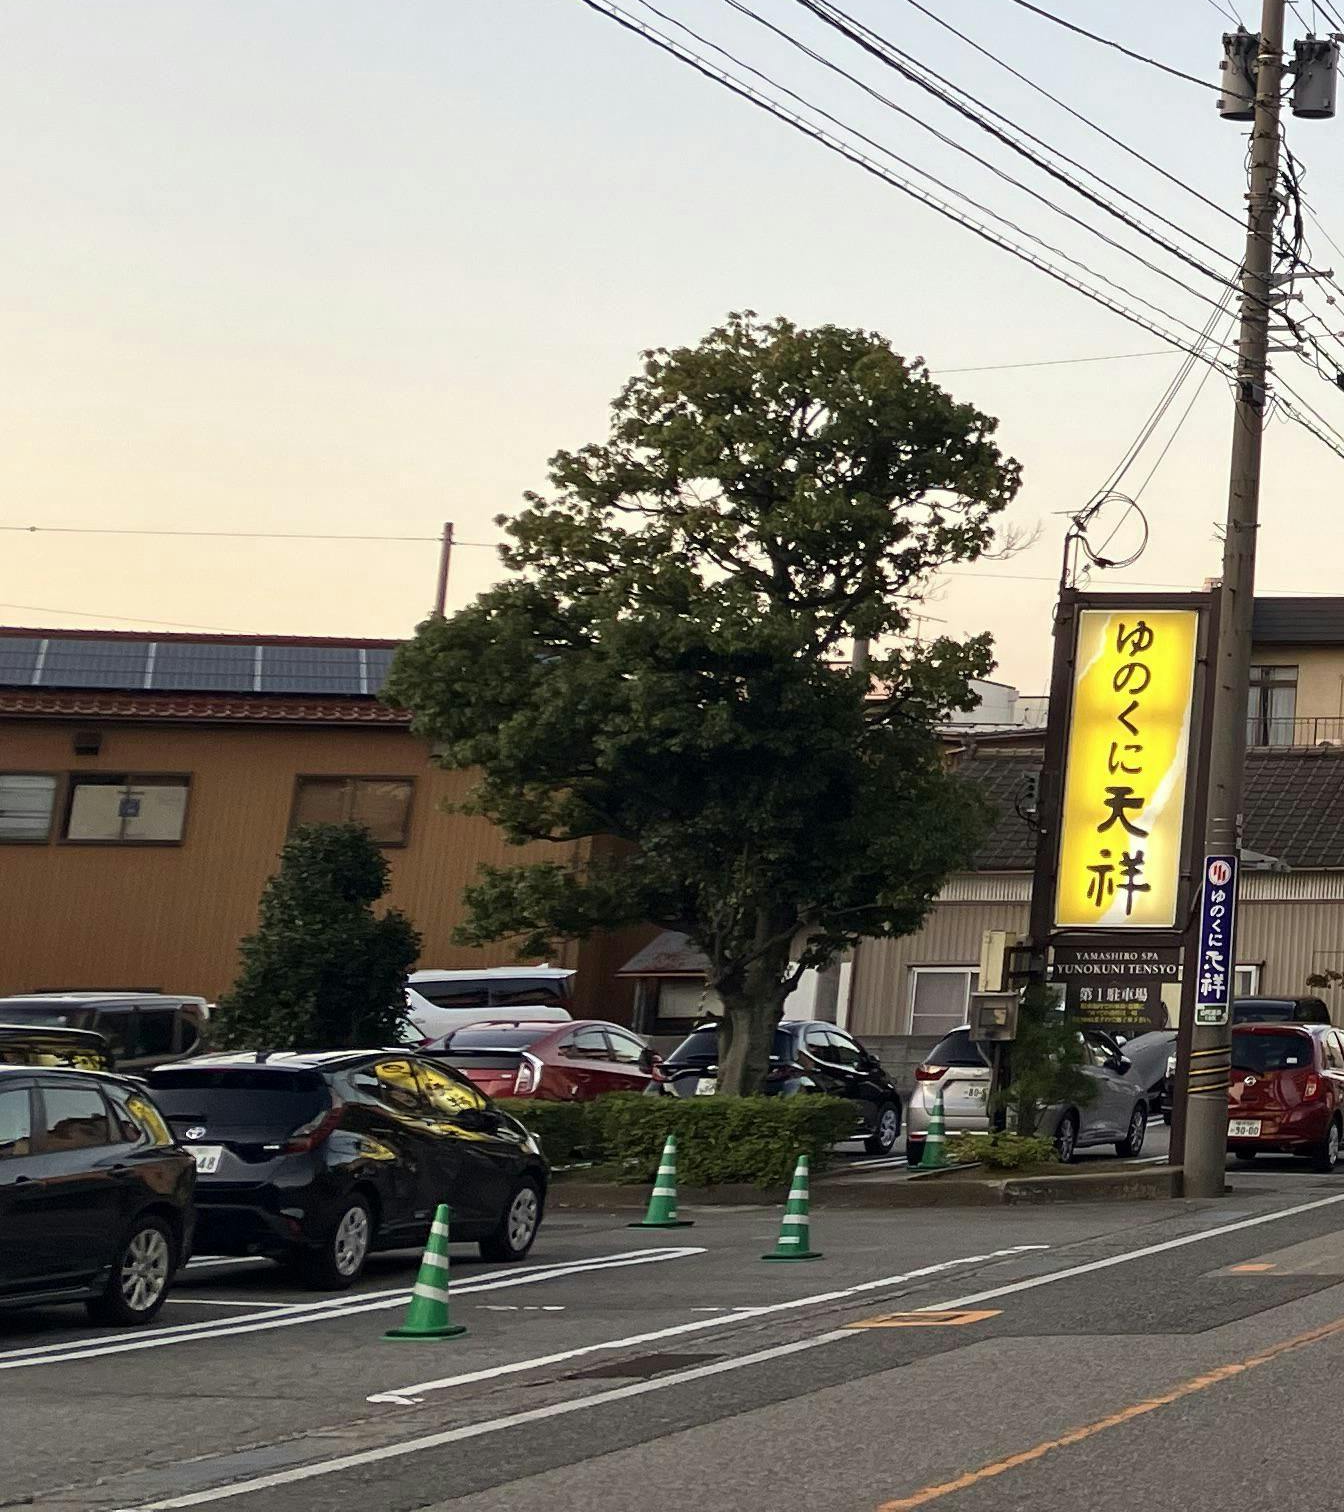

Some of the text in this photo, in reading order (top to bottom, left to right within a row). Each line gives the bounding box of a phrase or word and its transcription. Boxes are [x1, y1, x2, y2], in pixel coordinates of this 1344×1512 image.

[1086, 620, 1154, 916] ゆのくに天祥
[1057, 964, 1177, 975] YUNOKUNI TENSYO
[1075, 952, 1159, 961] YAMASHIRO SPA
[1200, 889, 1226, 999] ゆのくに天祥
